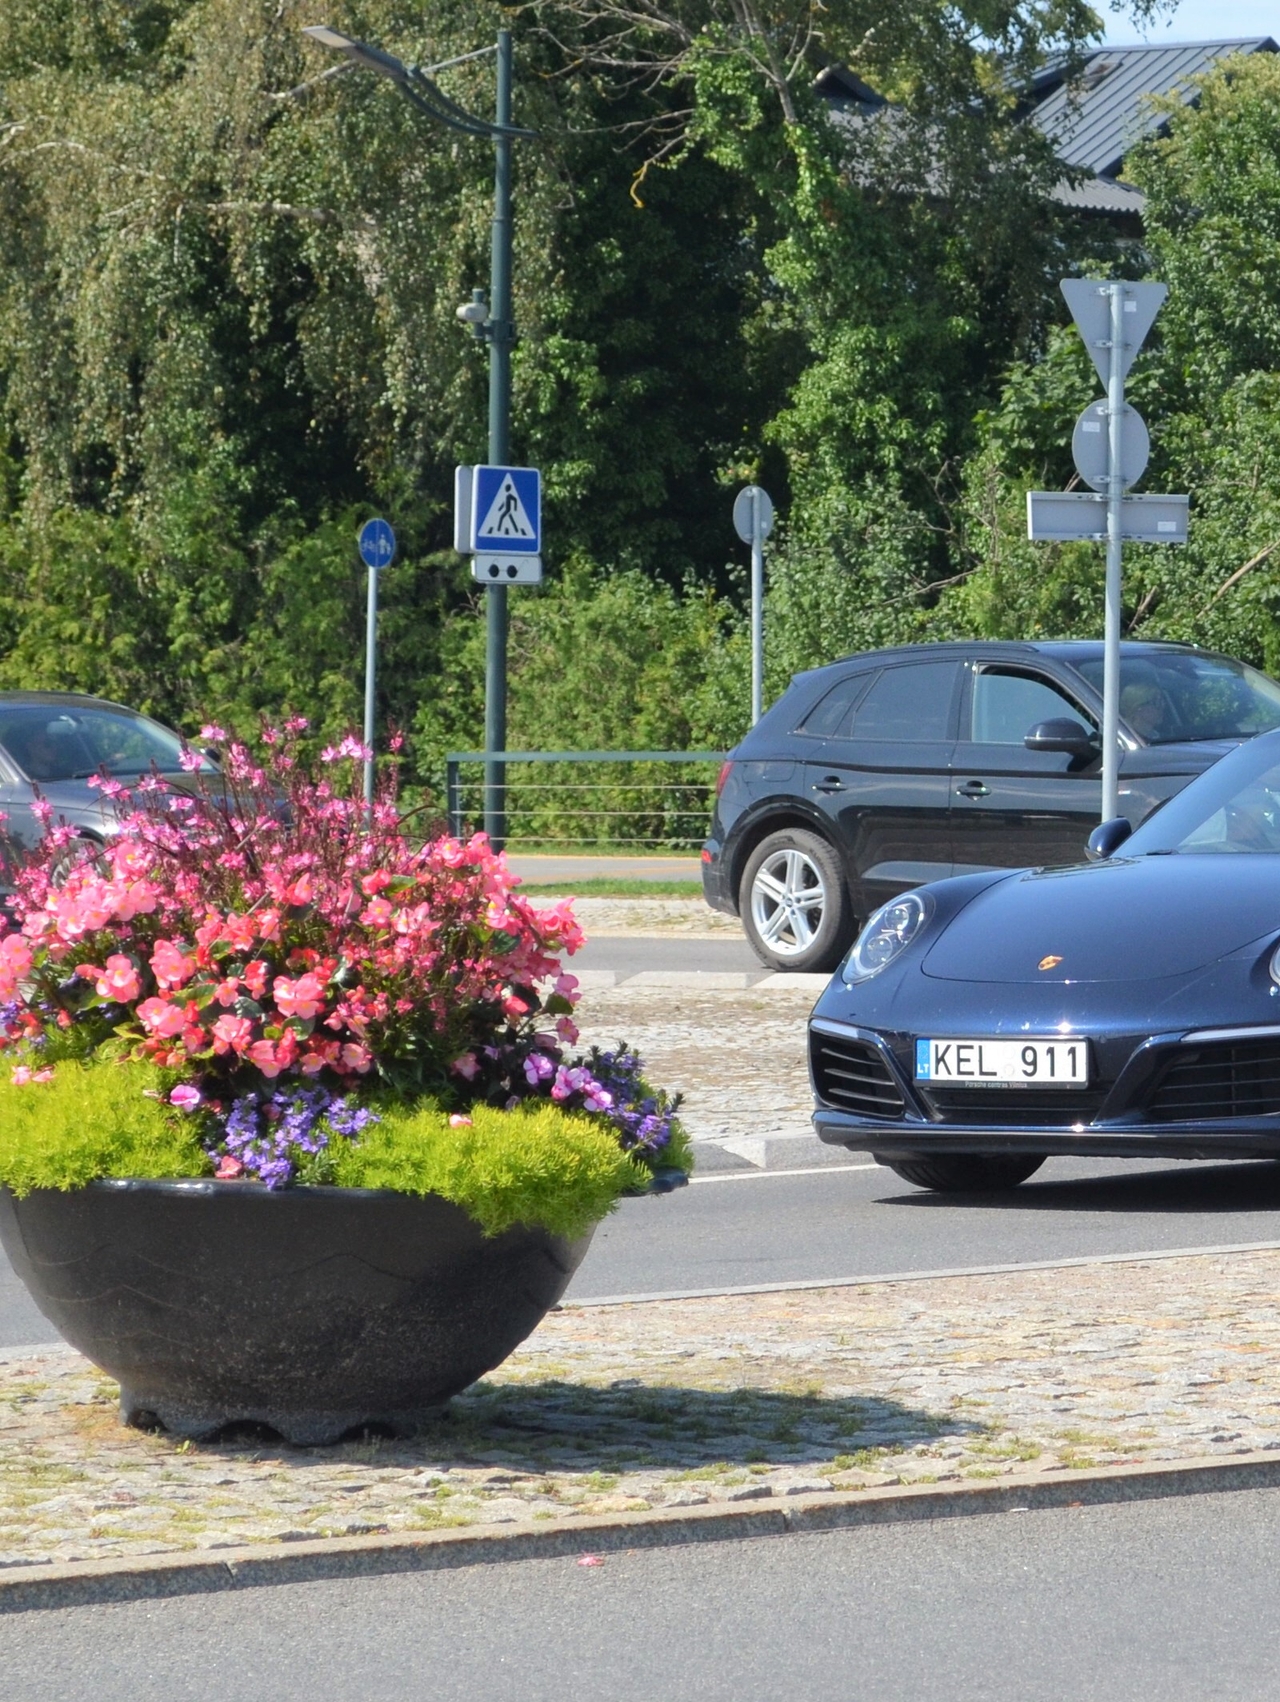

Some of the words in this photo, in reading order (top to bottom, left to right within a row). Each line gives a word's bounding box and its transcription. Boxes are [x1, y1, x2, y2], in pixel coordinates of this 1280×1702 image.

[917, 1063, 930, 1074] LT
[934, 1044, 998, 1076] KEL
[1021, 1045, 1077, 1078] 911
